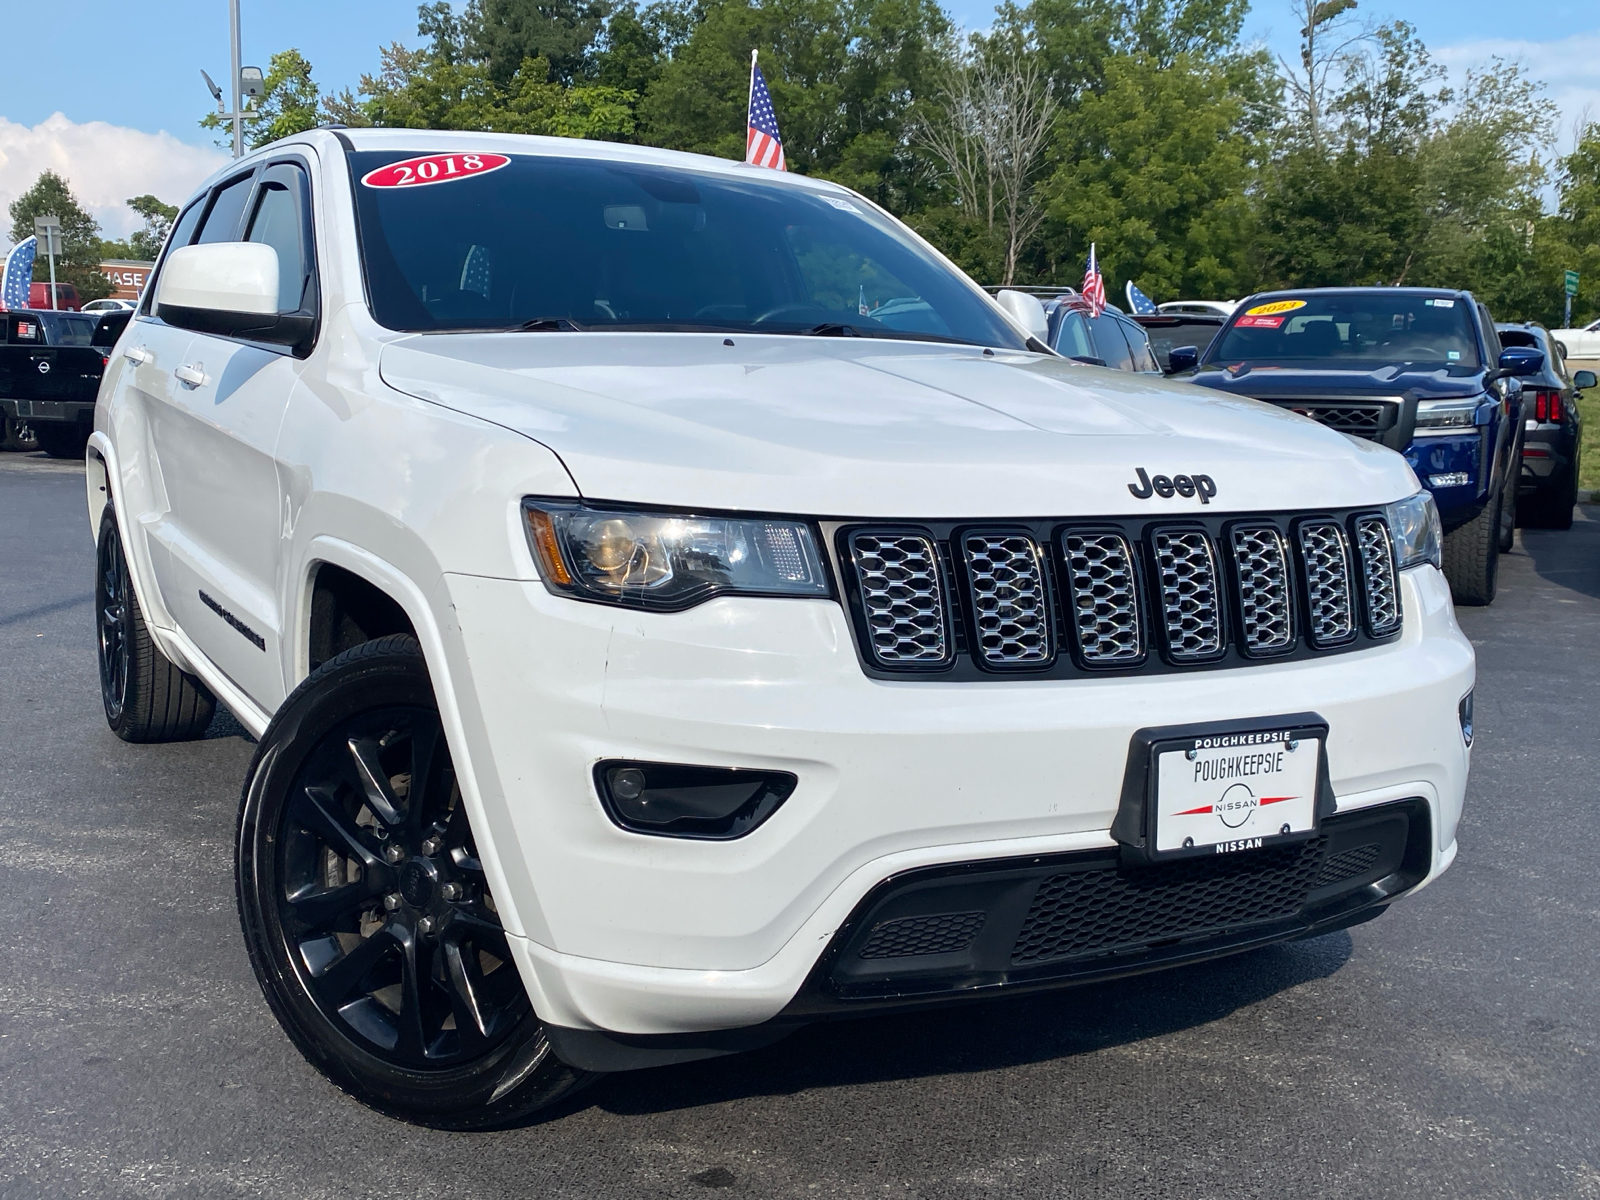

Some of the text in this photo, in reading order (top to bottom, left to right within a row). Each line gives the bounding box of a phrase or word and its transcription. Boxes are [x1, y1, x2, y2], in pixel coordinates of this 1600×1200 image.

[393, 154, 484, 186] 2018
[1256, 302, 1297, 314] 2023
[1127, 467, 1217, 505] Jeep
[1194, 731, 1291, 749] POUGHKEEPSIE
[1194, 751, 1284, 783] POUGHKEEPSIE
[1215, 799, 1258, 812] NISSAN
[1215, 838, 1263, 854] NISSAN
